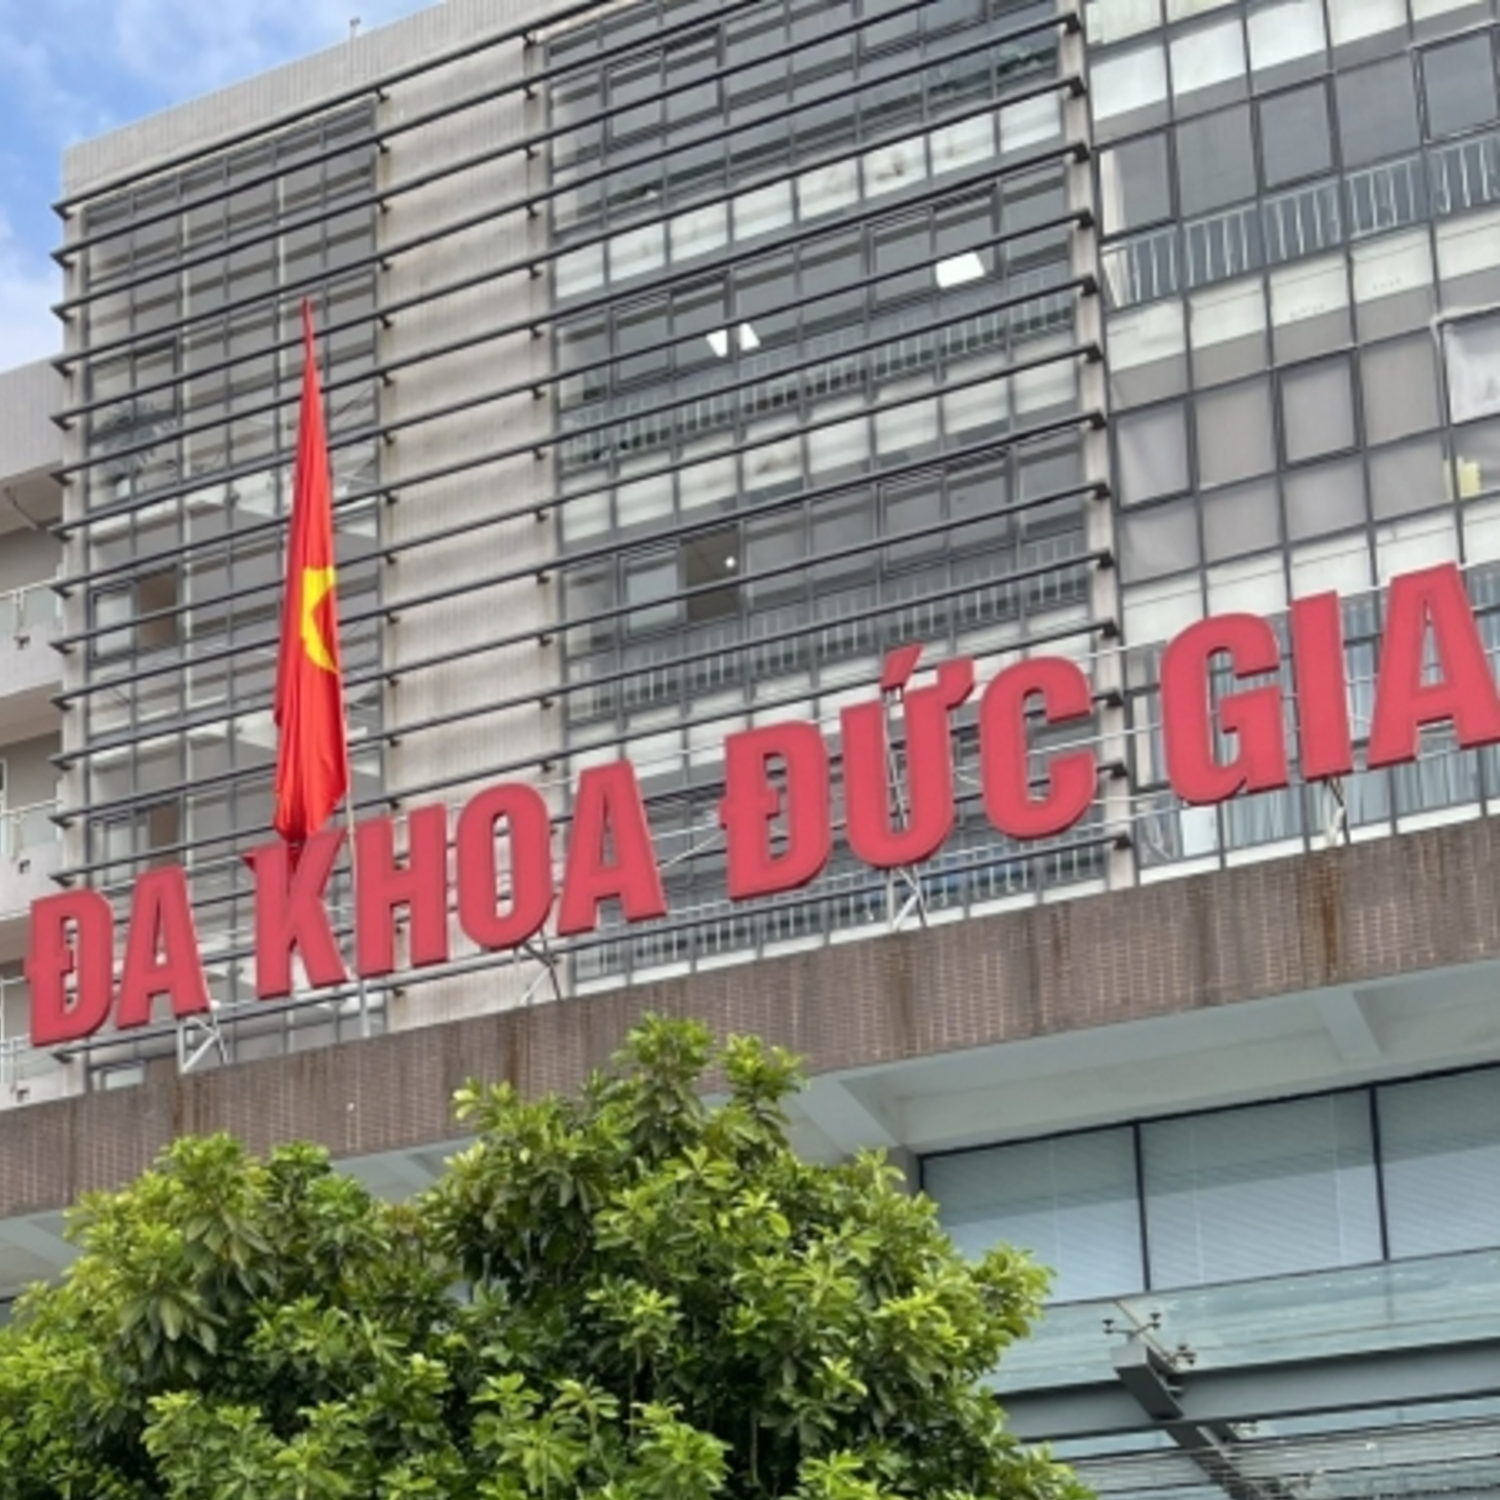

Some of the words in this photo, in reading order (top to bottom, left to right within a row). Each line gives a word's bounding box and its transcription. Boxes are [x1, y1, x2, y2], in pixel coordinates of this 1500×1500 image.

[26, 864, 211, 1048] ĐA
[254, 759, 668, 1000] KHOA
[719, 643, 1097, 901] ĐỨC
